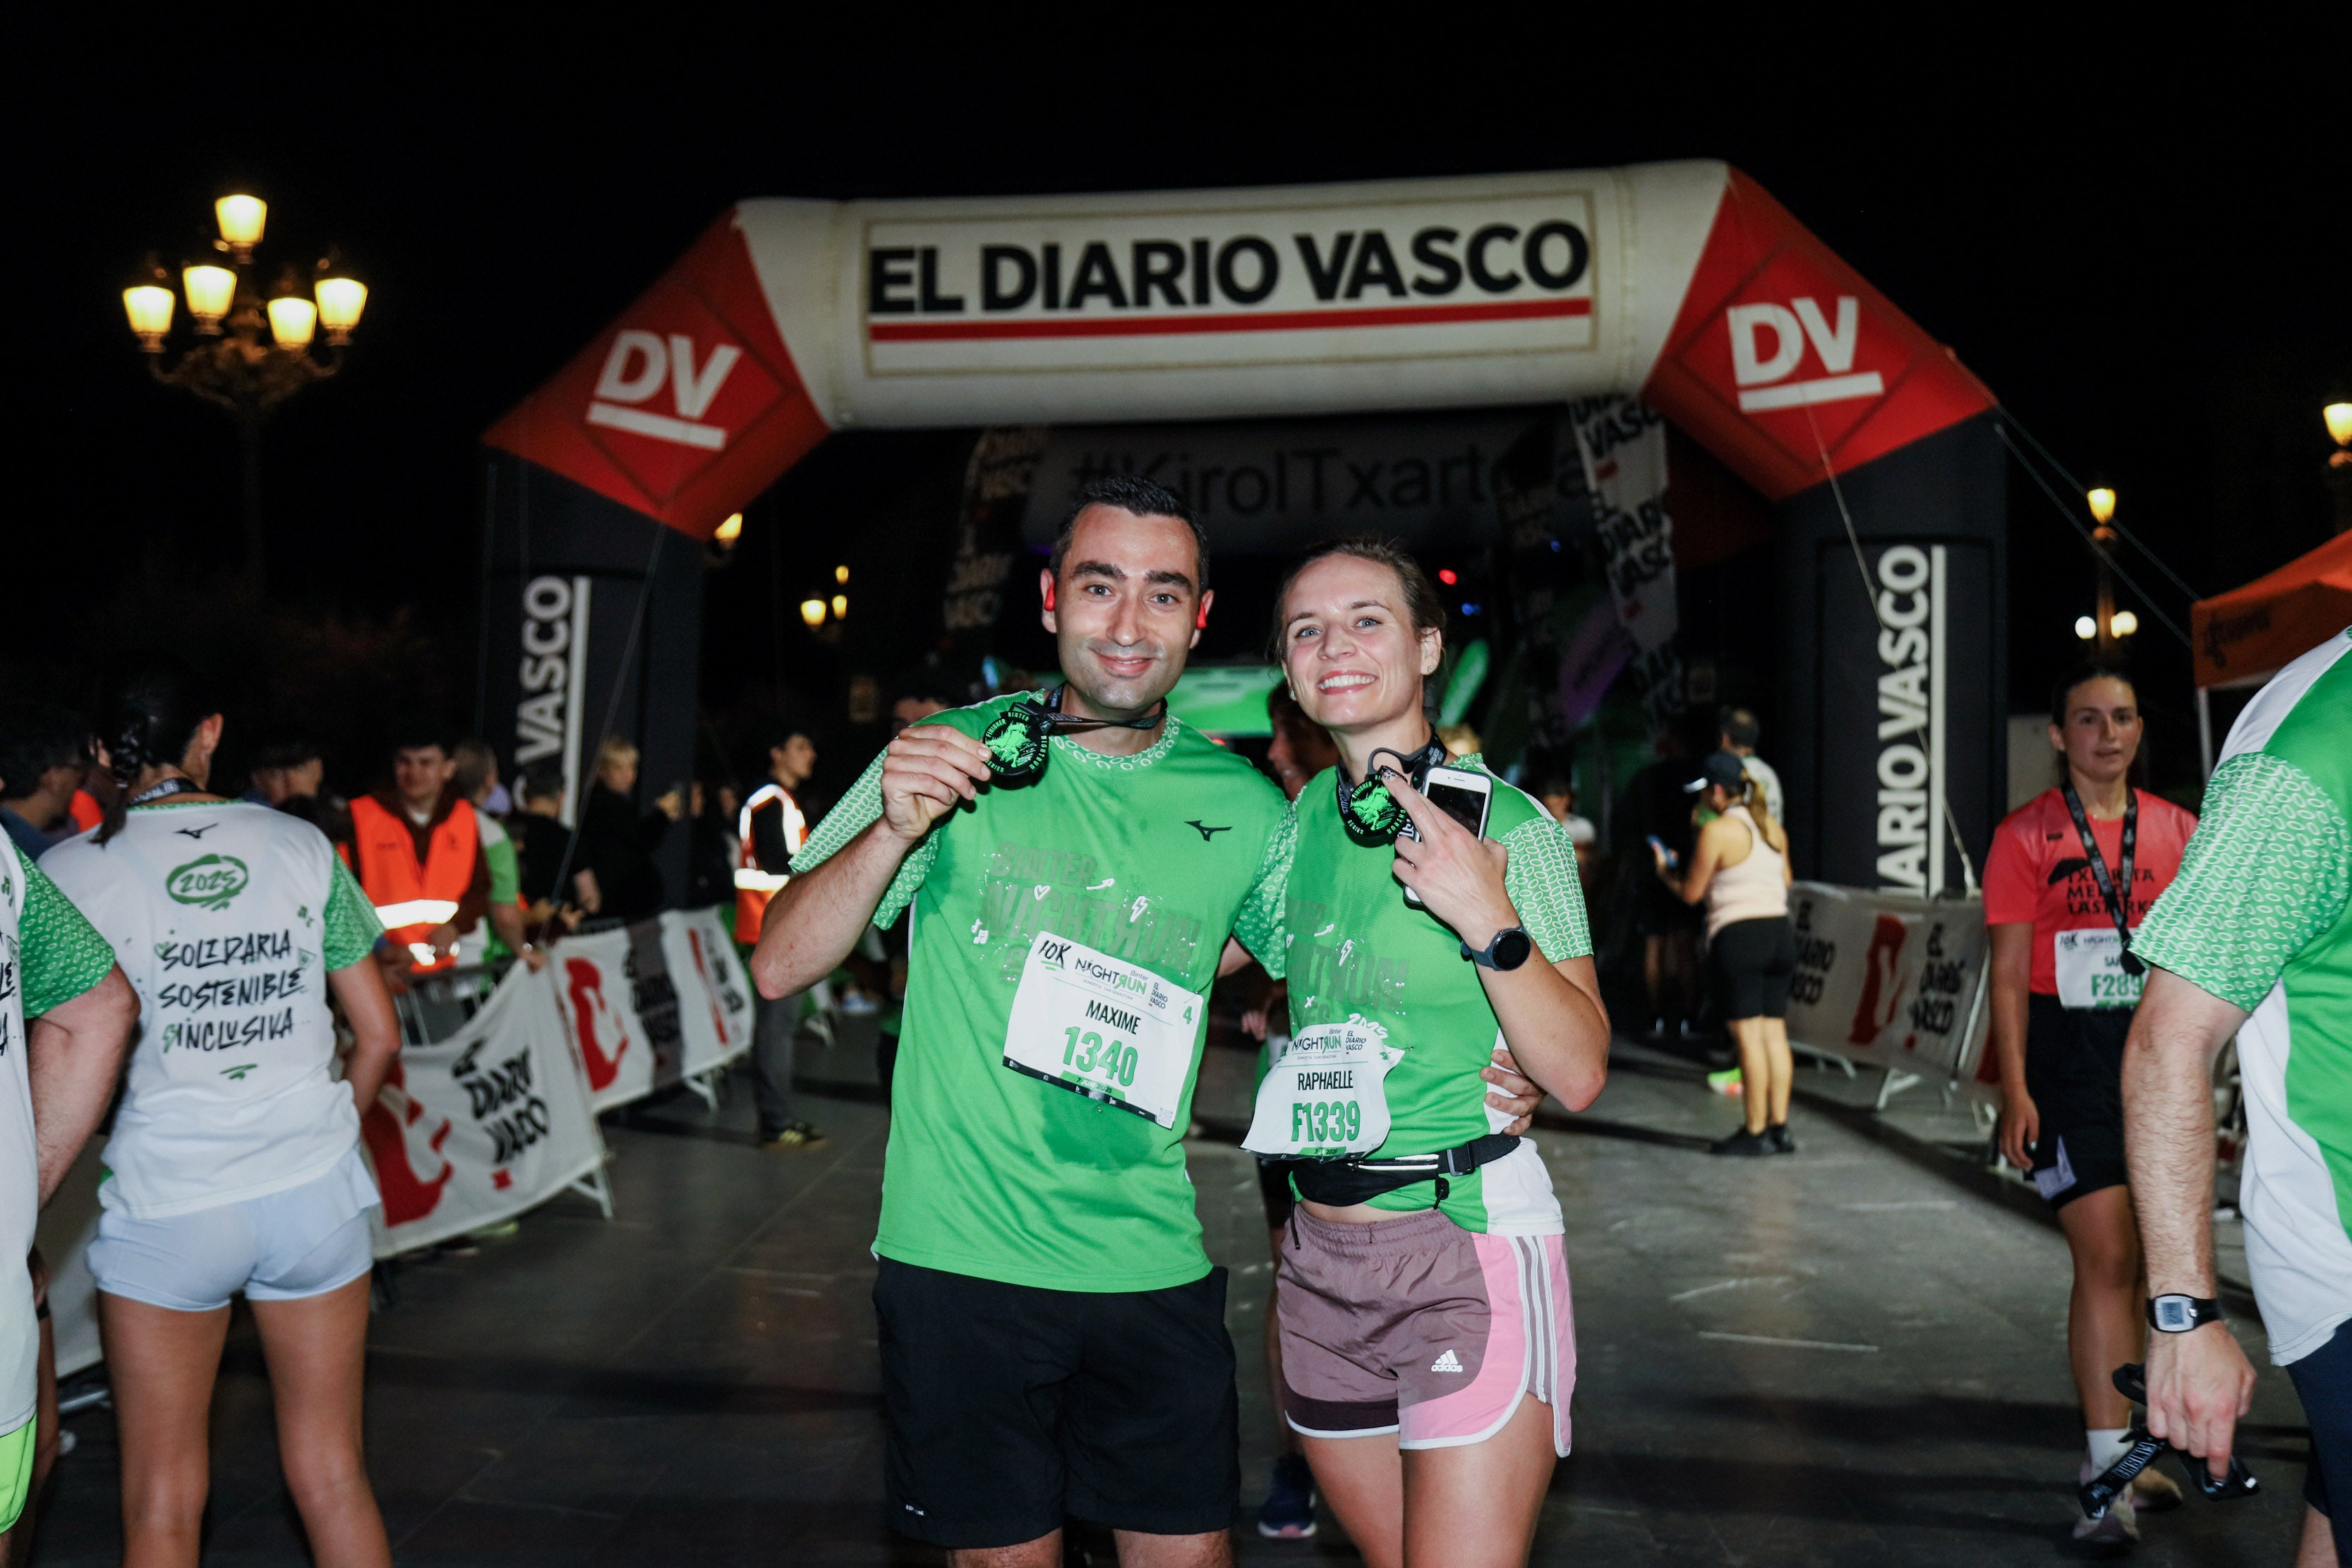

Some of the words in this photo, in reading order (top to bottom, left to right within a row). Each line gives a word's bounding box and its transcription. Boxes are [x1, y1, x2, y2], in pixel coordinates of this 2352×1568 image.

[870, 248, 963, 313] EL
[983, 236, 1279, 310] DIARIO
[1297, 221, 1588, 301] VASCO
[1726, 296, 1859, 385] DV
[594, 329, 741, 419] DV
[1877, 545, 1929, 742] VASCO
[514, 575, 572, 766] VASCO
[985, 718, 1007, 738] FINISHER
[1008, 711, 1030, 722] BINTER
[1029, 735, 1048, 770] NIGHTRUN
[985, 760, 1005, 773] ERIES
[1351, 780, 1373, 800] FINISHER
[1386, 809, 1406, 835] GHTRUN
[179, 869, 238, 894] 2025
[2060, 931, 2078, 946] 10K
[1038, 940, 1071, 970] 10K
[1130, 970, 1149, 981] Binter
[1153, 982, 1159, 990] EL
[159, 967, 306, 1012] SOSTENIBLE
[1151, 989, 1168, 1002] DIARIO
[1150, 996, 1166, 1009] VASCO
[1183, 1006, 1192, 1024] 4
[176, 1007, 294, 1051] INCLUSIVA
[1085, 999, 1141, 1035] MAXIME
[1063, 1026, 1138, 1087] 1340
[1080, 1079, 1097, 1087] JUN
[1097, 1084, 1112, 1094] 2025
[1298, 1070, 1353, 1091] RAPHAELLE
[1291, 1101, 1361, 1142] F1339
[1430, 1364, 1464, 1373] adidas
